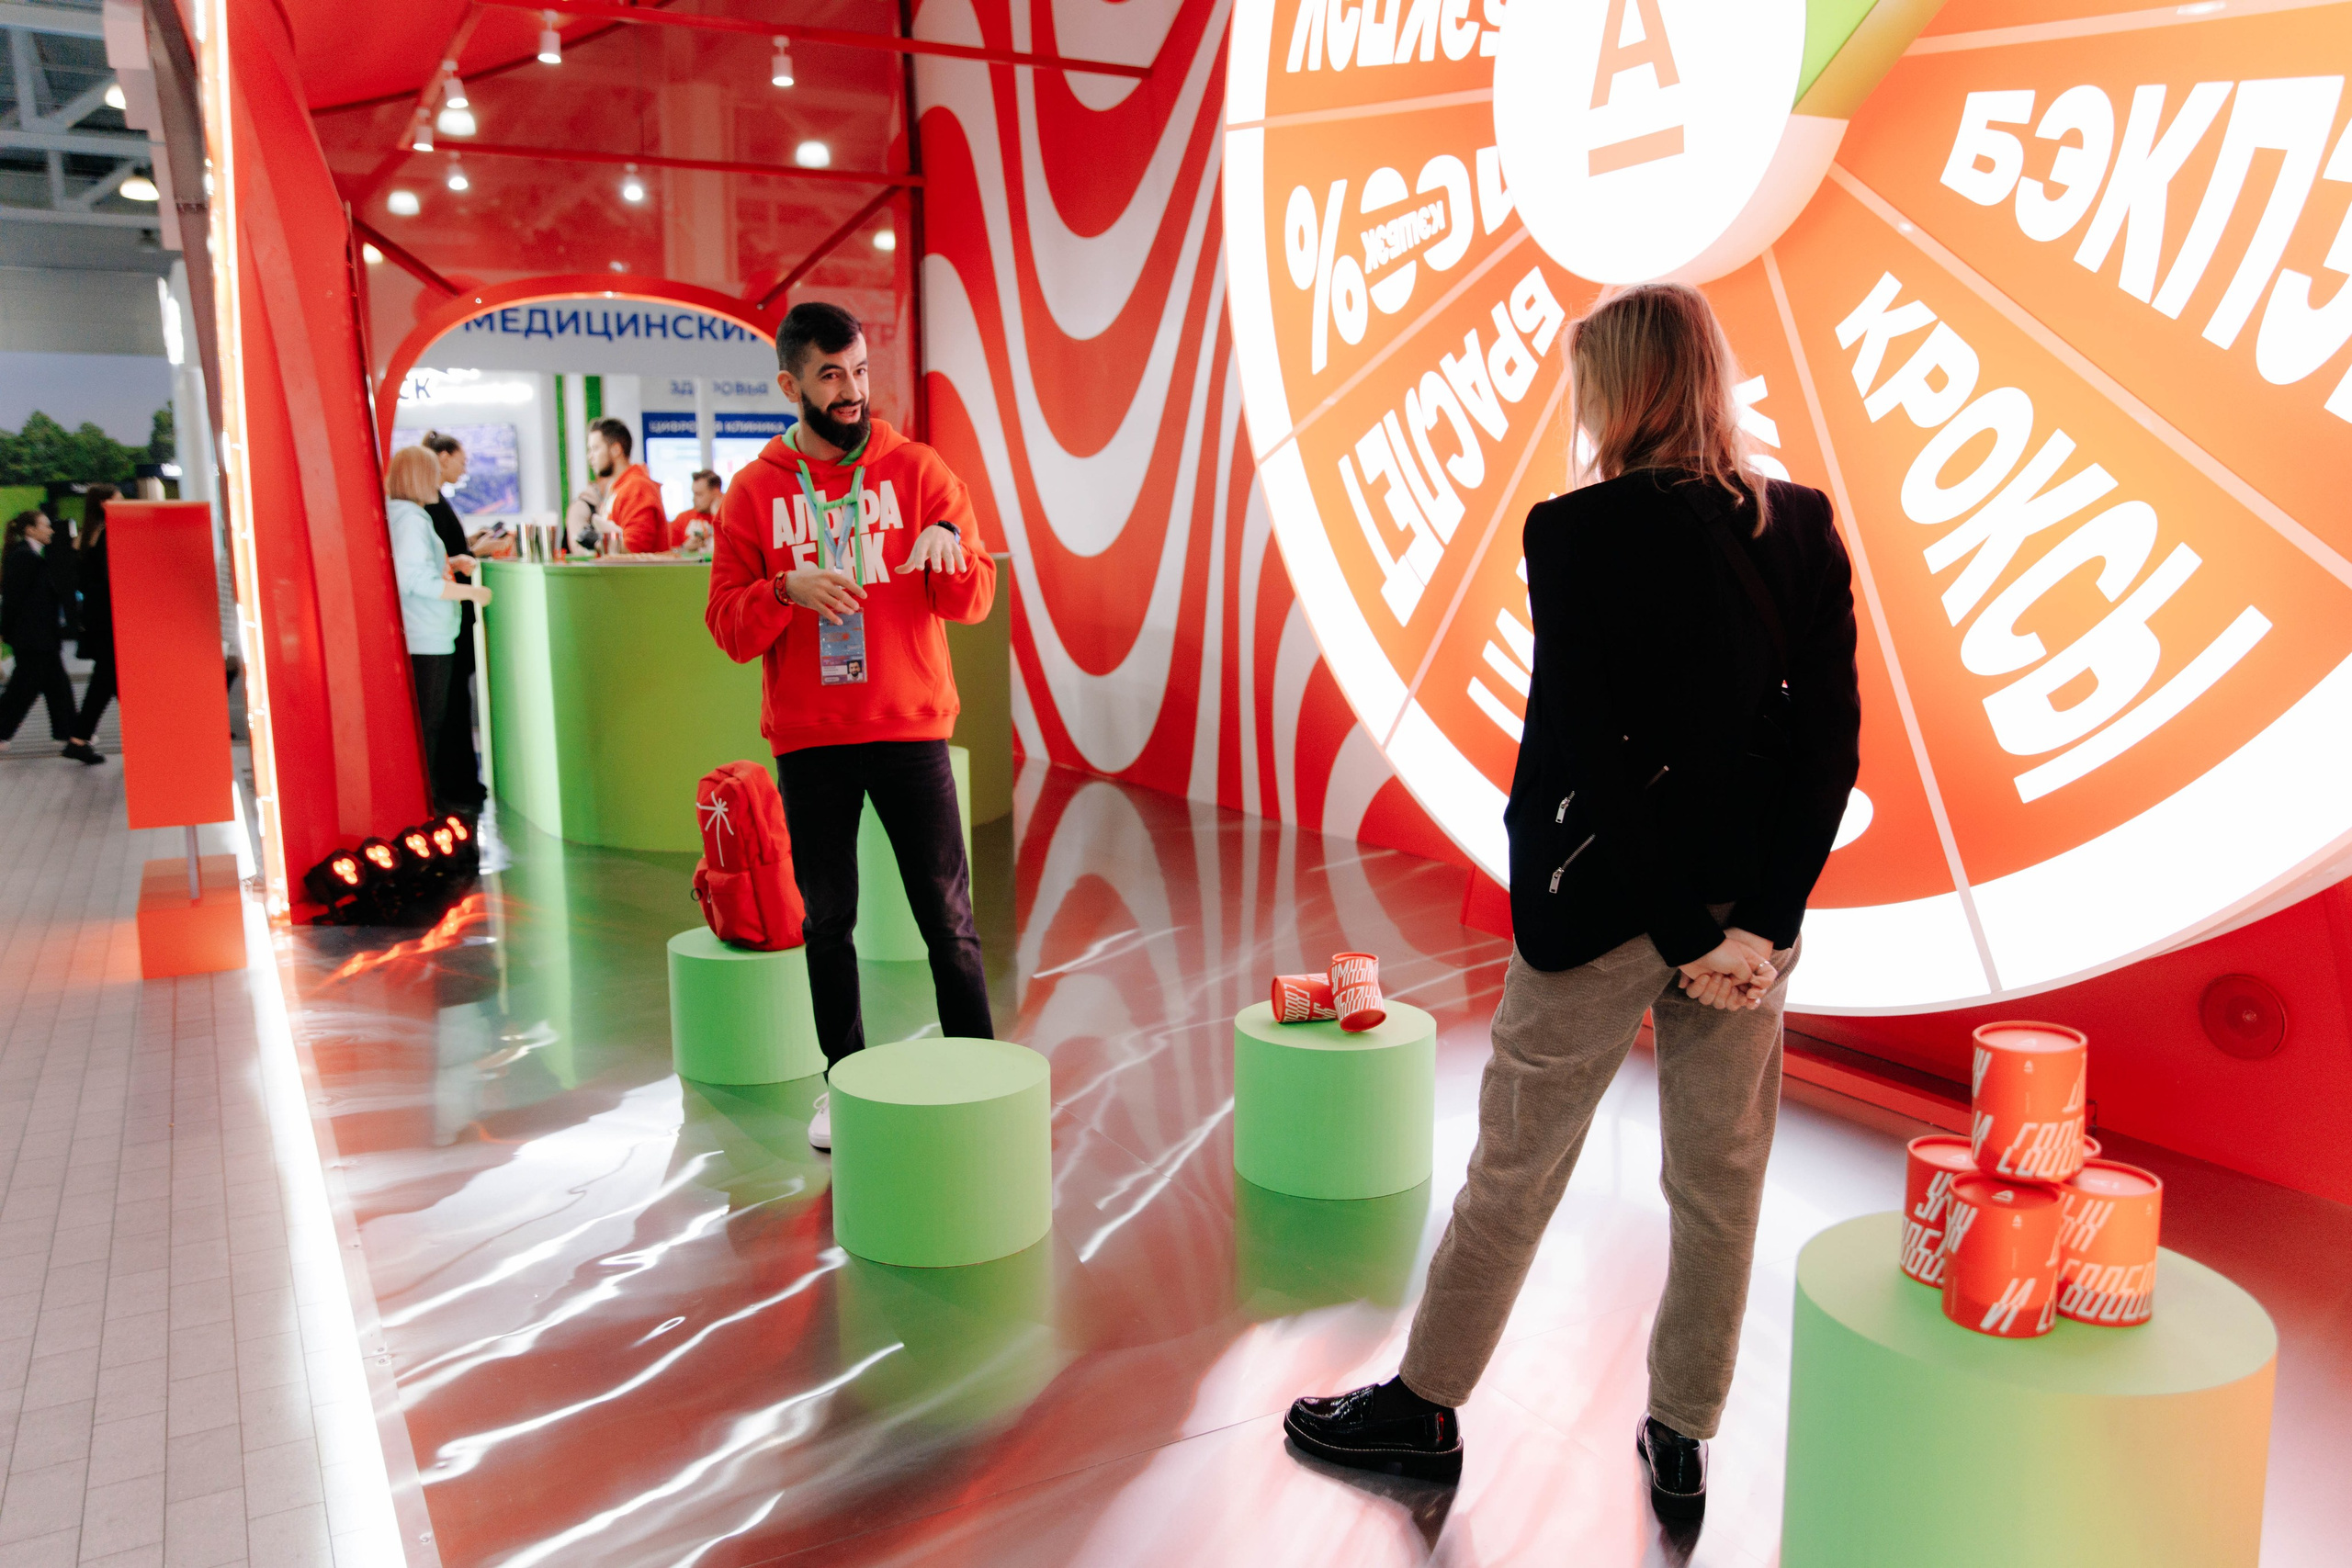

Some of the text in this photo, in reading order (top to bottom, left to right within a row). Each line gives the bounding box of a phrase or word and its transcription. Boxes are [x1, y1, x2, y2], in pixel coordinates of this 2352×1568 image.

[670, 378, 769, 397] ЗДОВЬЯ
[1361, 200, 1445, 275] КЭШБЭК
[1939, 74, 2352, 423] БЭКПЭ
[1338, 265, 1566, 627] БРАСЛЕТ
[1834, 270, 2274, 804] КРОКСЫ
